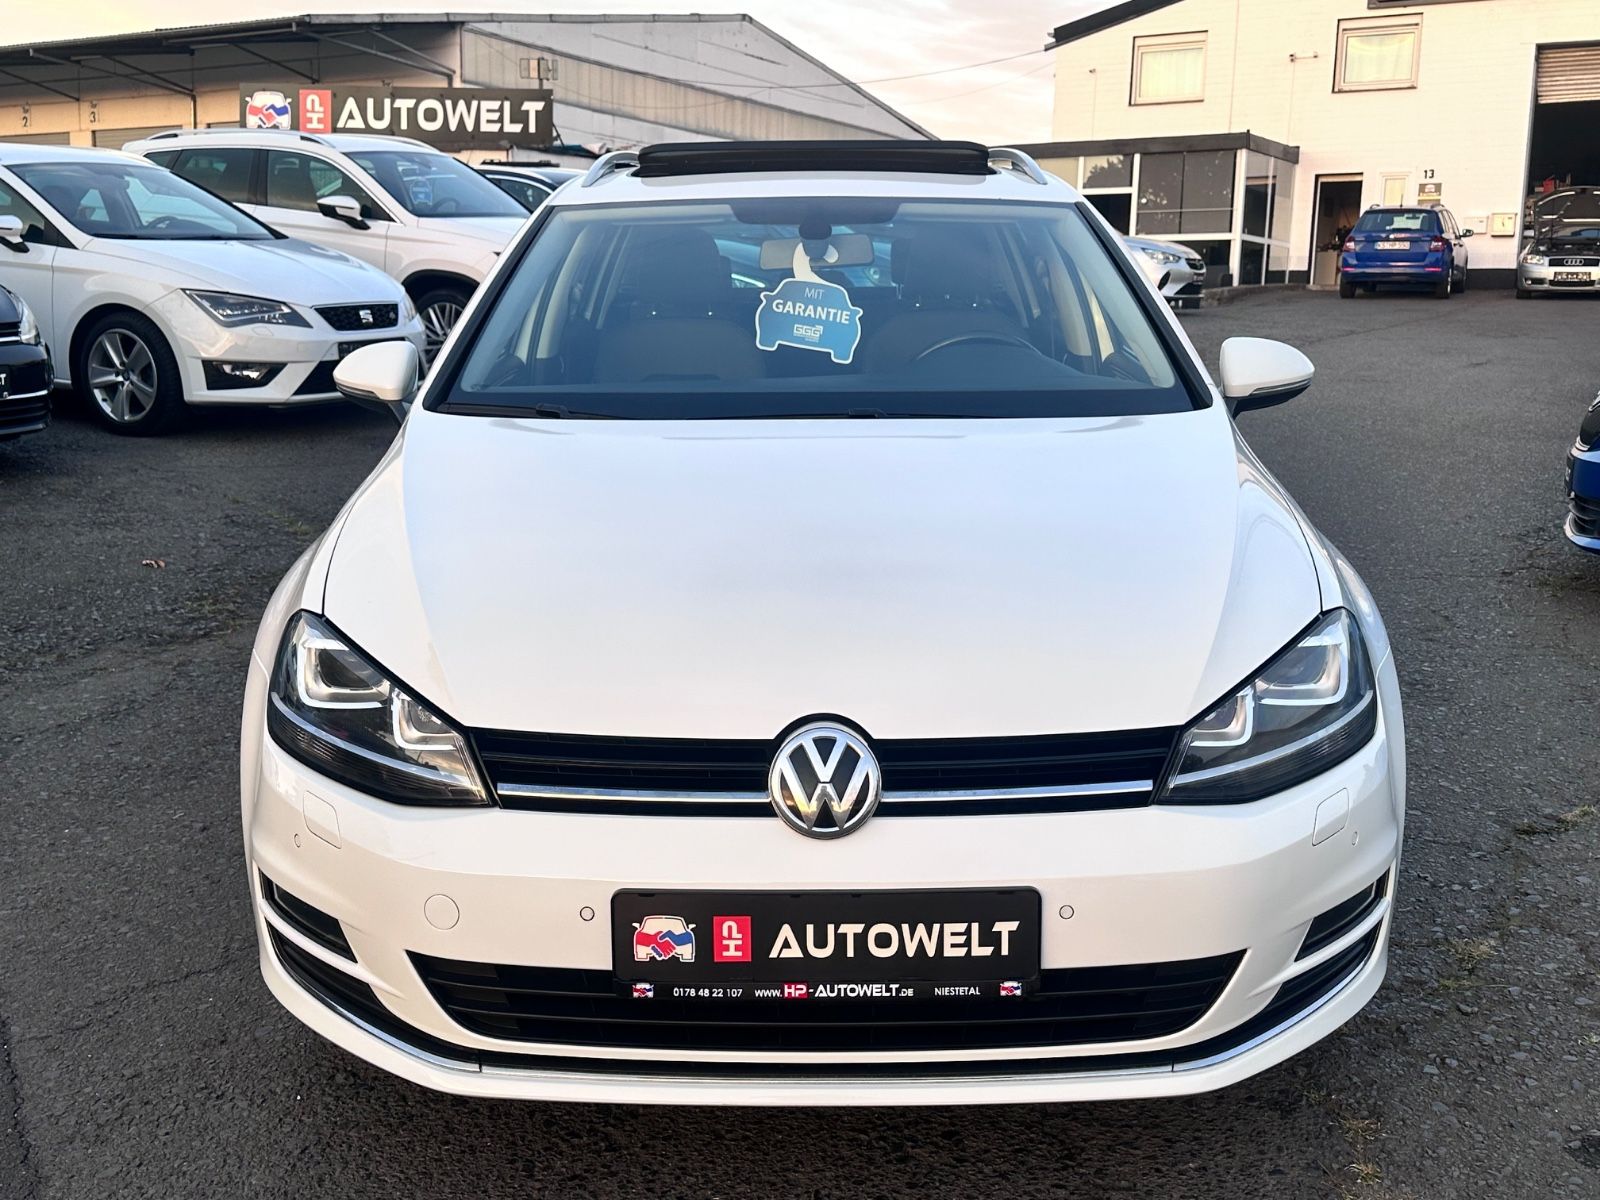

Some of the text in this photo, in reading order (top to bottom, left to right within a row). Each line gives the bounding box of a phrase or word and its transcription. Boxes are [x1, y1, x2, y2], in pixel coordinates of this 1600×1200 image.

[336, 96, 546, 134] AUTOWELT
[1423, 168, 1435, 179] 13
[804, 287, 825, 300] MIT
[772, 299, 851, 324] GARANTIE
[722, 920, 1021, 959] HP AUTOWELT
[673, 987, 696, 997] 0178
[698, 988, 710, 997] 48
[711, 988, 724, 997] 22
[726, 988, 743, 998] 107
[934, 986, 981, 996] NIESTETAL
